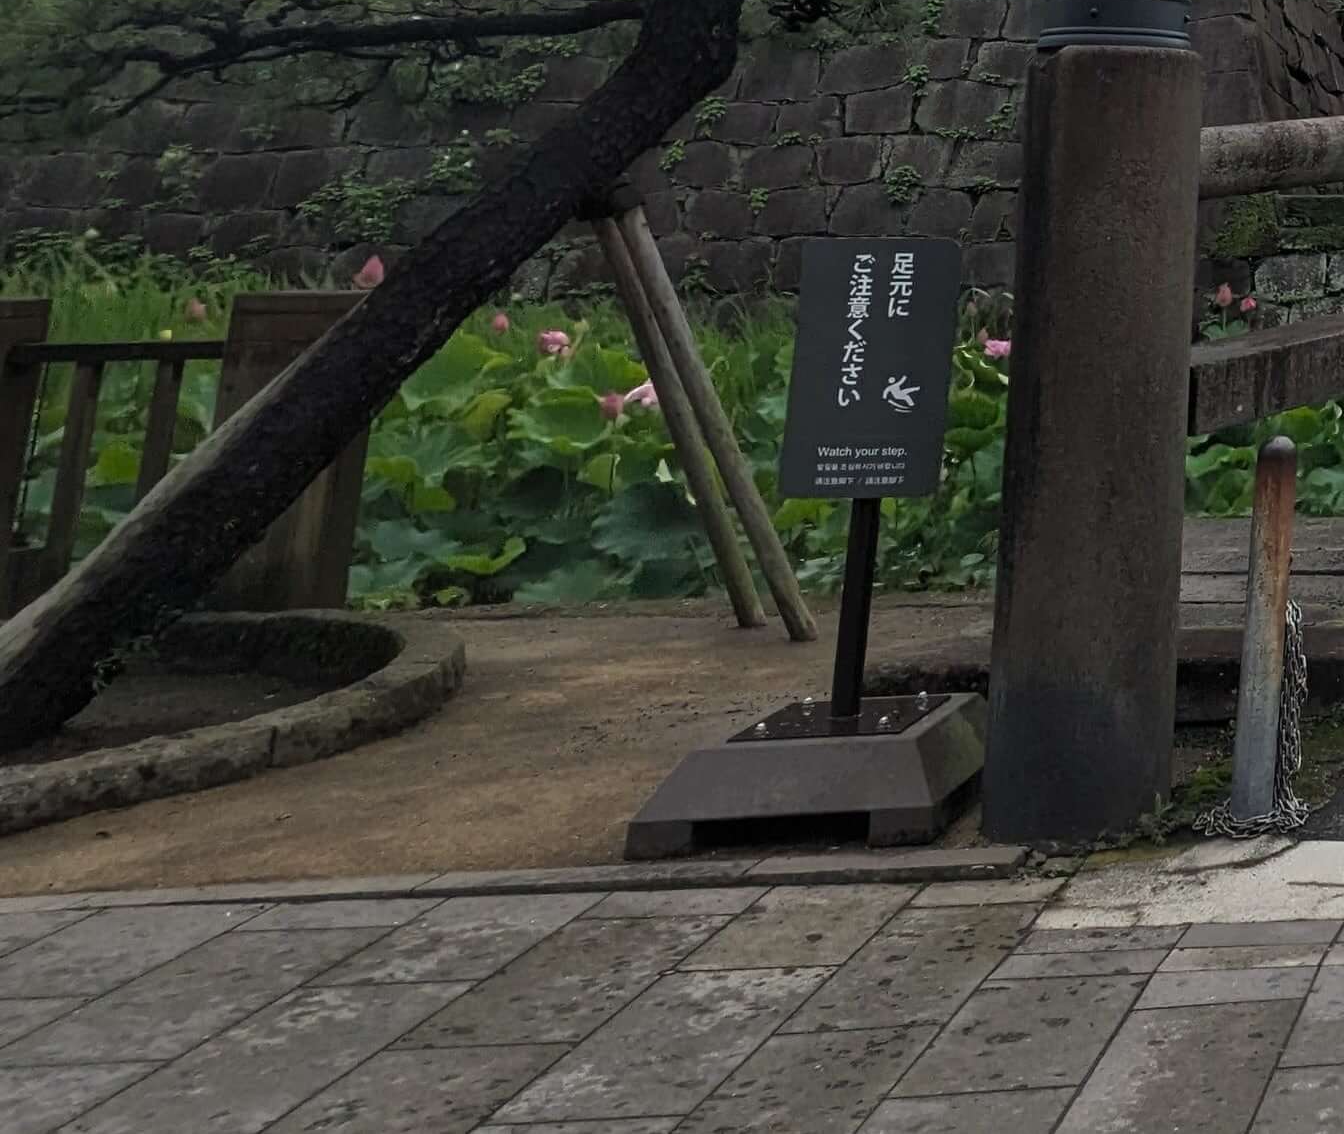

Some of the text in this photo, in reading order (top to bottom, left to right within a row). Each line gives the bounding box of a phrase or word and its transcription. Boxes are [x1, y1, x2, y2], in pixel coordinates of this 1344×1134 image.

[888, 252, 914, 318] 足元に
[838, 253, 876, 407] ご注意ください
[818, 447, 907, 458] Watch your step.
